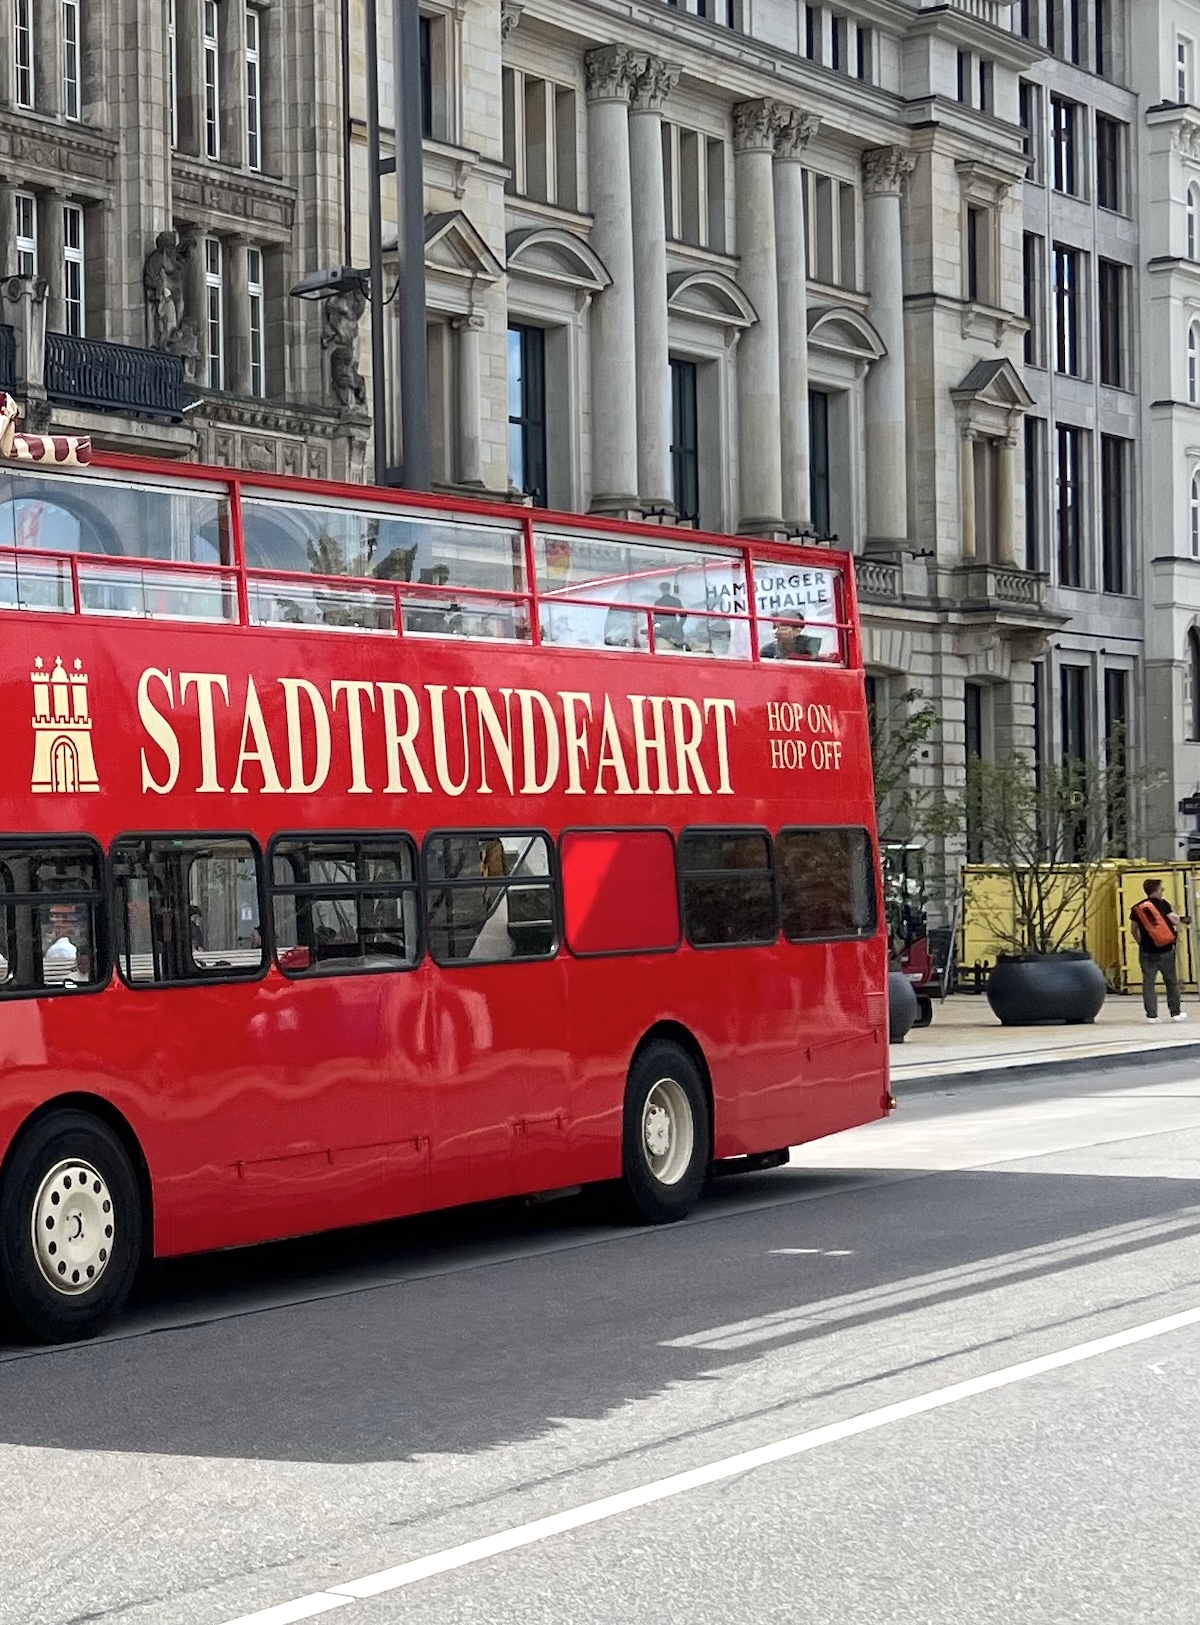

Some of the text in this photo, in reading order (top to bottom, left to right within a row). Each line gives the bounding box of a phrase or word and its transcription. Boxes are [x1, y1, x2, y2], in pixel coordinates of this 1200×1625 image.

[706, 572, 827, 597] HAMURGER
[706, 589, 828, 613] KUNTHALLE
[138, 666, 738, 796] STADTRUNDFAHRT
[766, 702, 833, 733] HOP ON
[770, 740, 842, 770] HOP OFF
